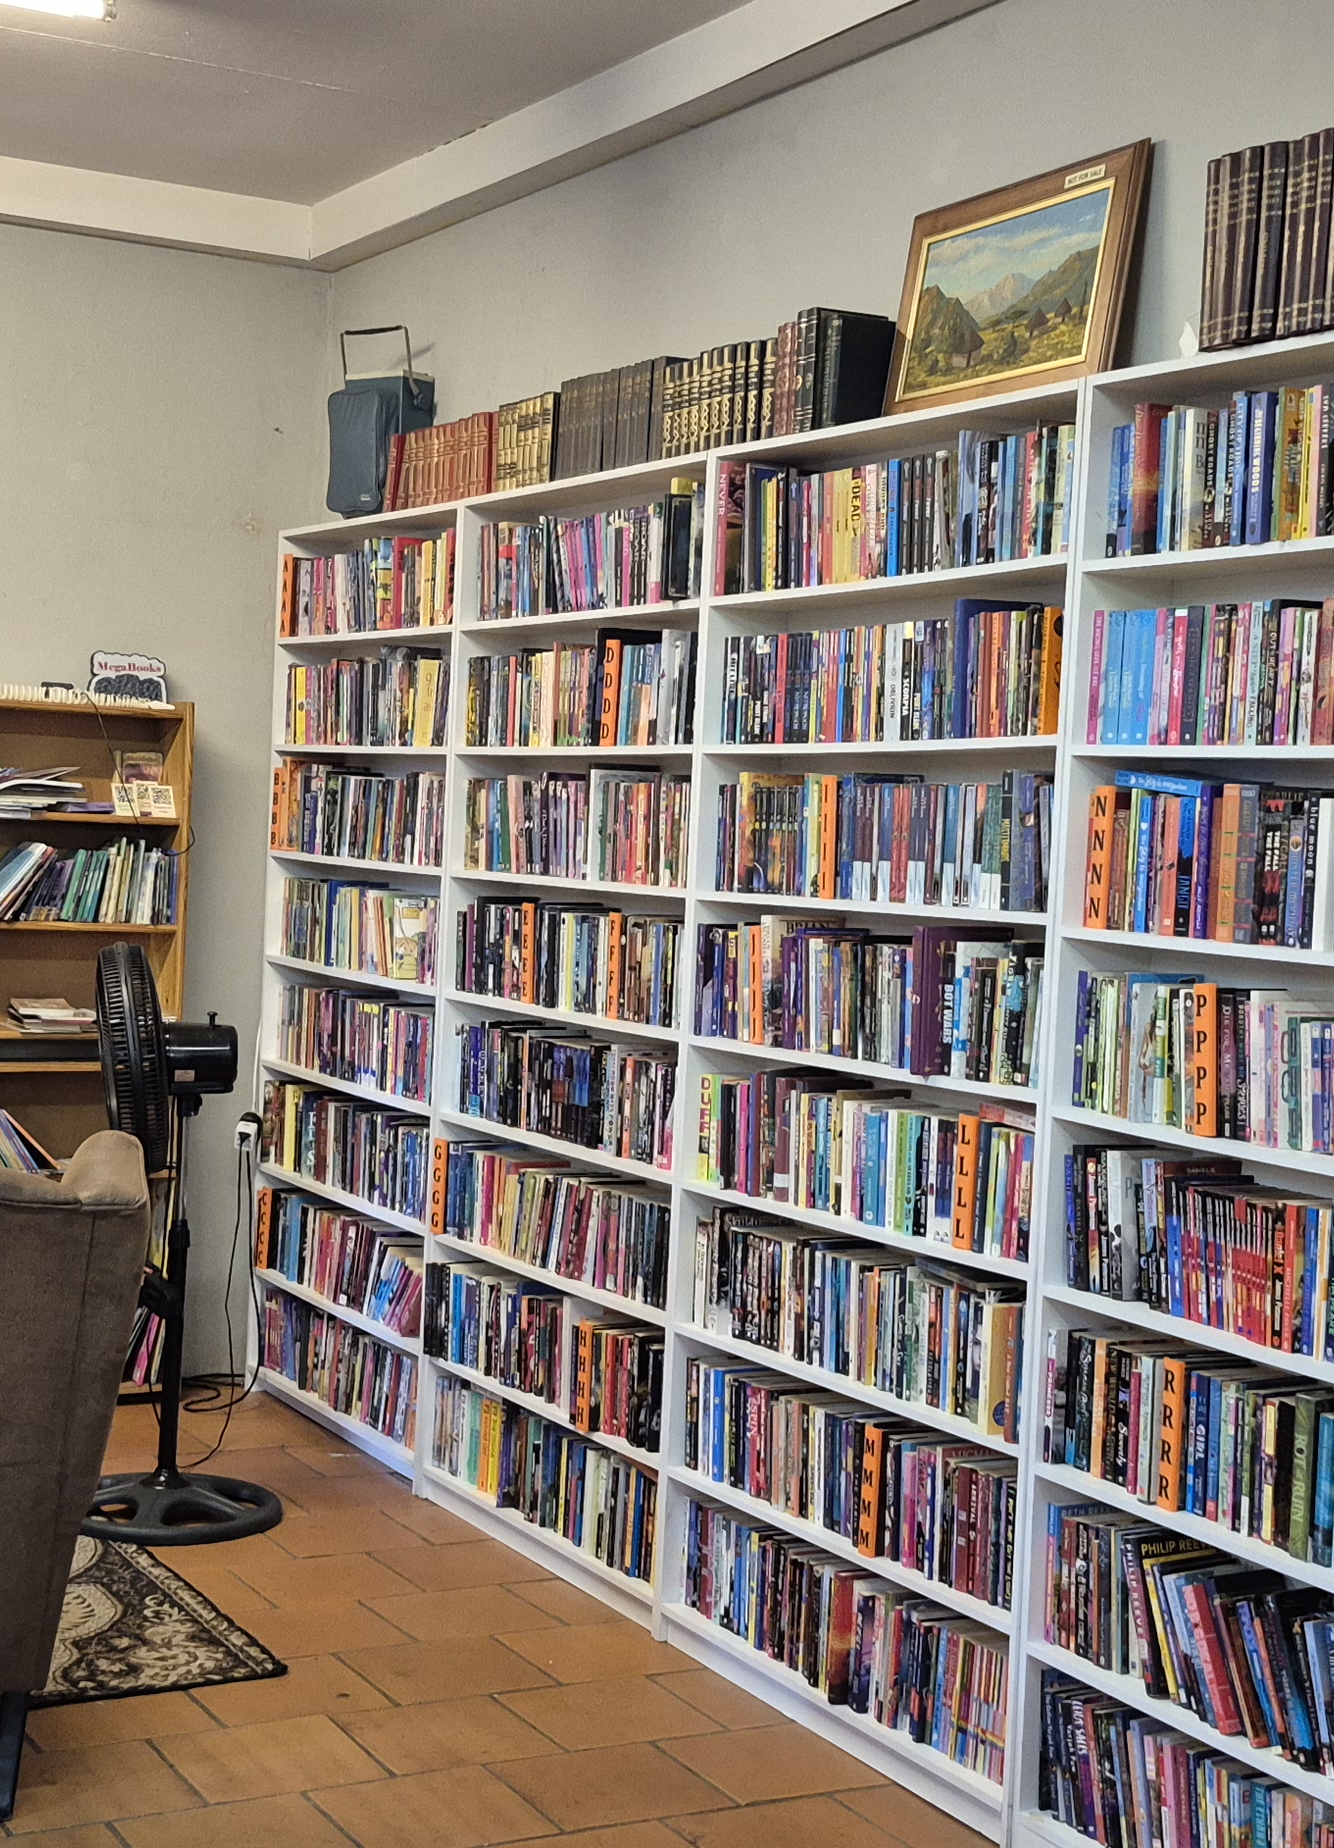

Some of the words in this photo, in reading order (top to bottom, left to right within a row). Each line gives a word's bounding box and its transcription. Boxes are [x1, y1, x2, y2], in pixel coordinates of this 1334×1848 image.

[1088, 168, 1103, 180] SALE
[850, 485, 862, 522] DEAD
[901, 677, 910, 716] SCORPIA
[1308, 806, 1318, 831] blue
[1306, 835, 1315, 865] moon
[943, 984, 955, 1008] BOT
[942, 1010, 954, 1044] WARS
[1195, 1423, 1206, 1461] GIRL
[1295, 1434, 1308, 1467] ROT
[1291, 1482, 1305, 1523] RUIN
[1124, 1543, 1138, 1587] PHILIP
[1131, 1592, 1144, 1635] REEVE
